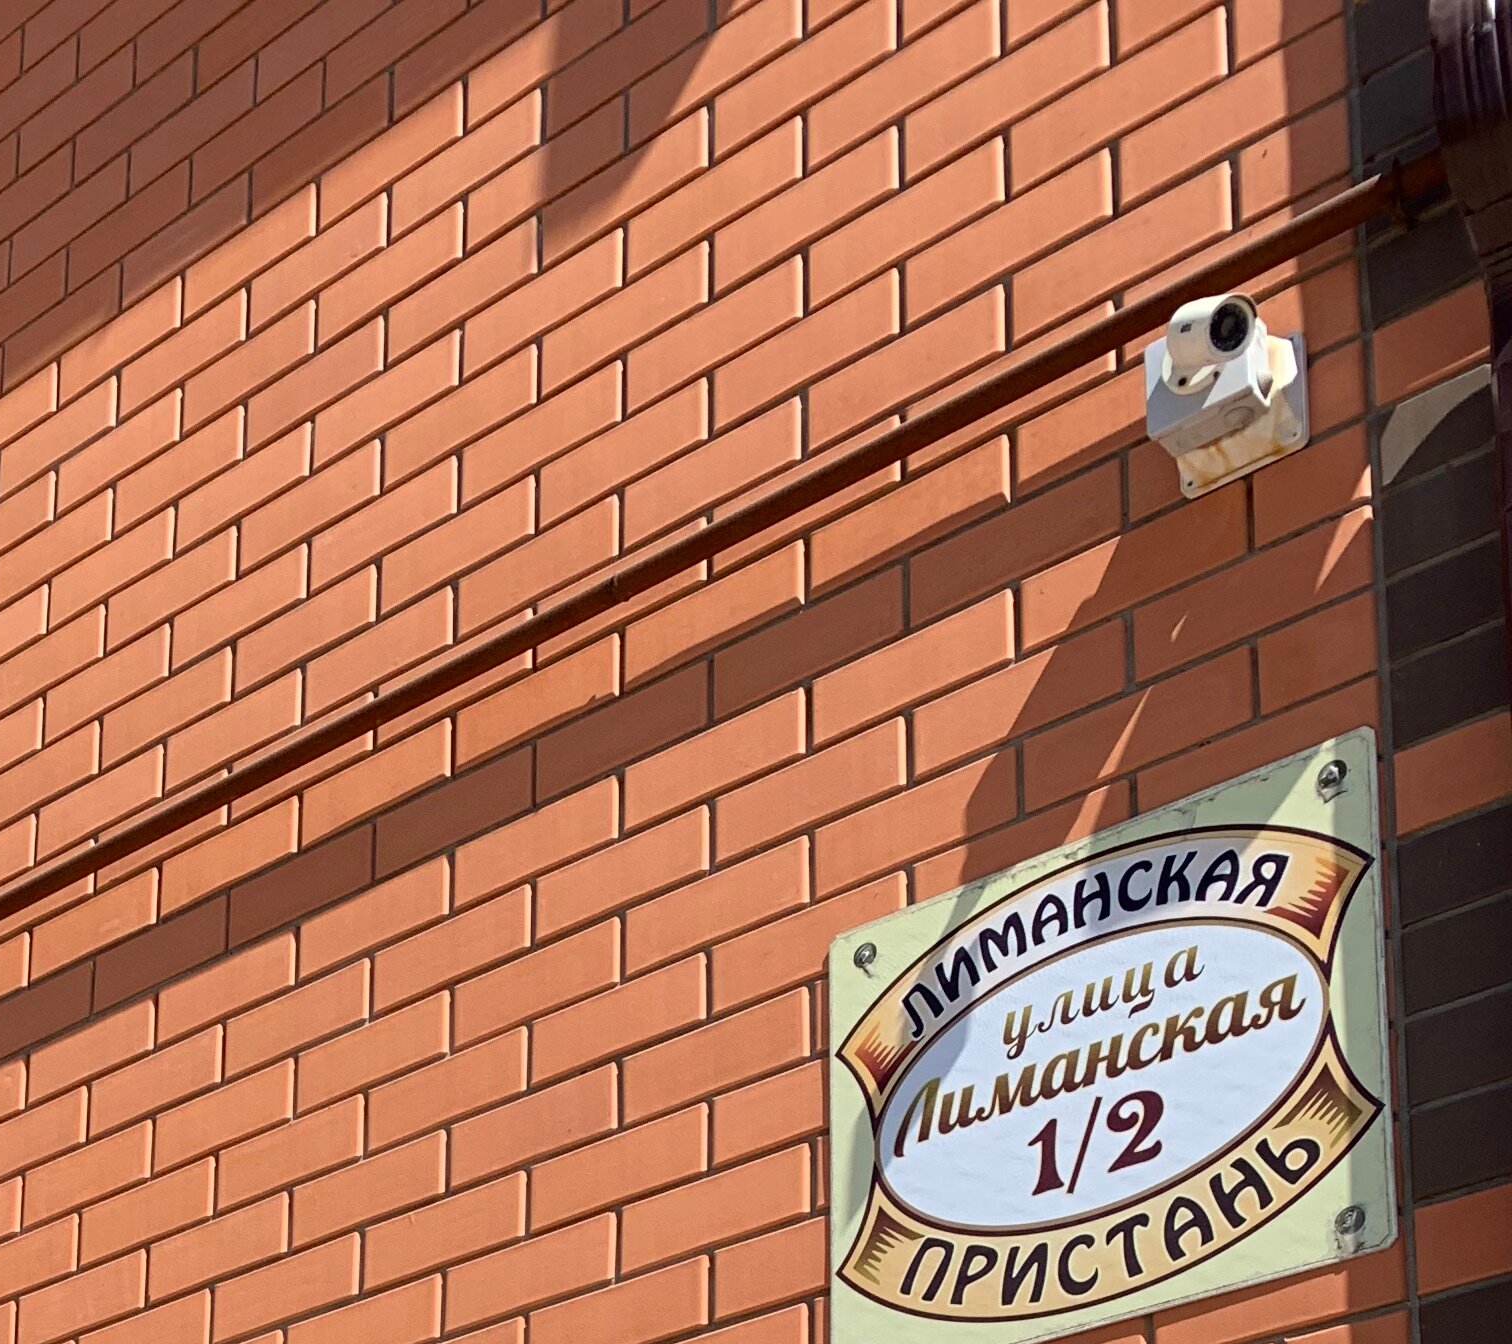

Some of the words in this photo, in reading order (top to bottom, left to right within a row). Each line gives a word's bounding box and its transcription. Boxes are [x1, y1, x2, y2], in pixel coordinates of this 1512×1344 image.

[901, 847, 1291, 1040] ЛИМАНСКАЯ
[1002, 943, 1206, 1060] улица
[893, 972, 1307, 1158] Лиманская
[1028, 1089, 1166, 1196] 1/2
[898, 1136, 1322, 1307] ПРИСТАНЬ
